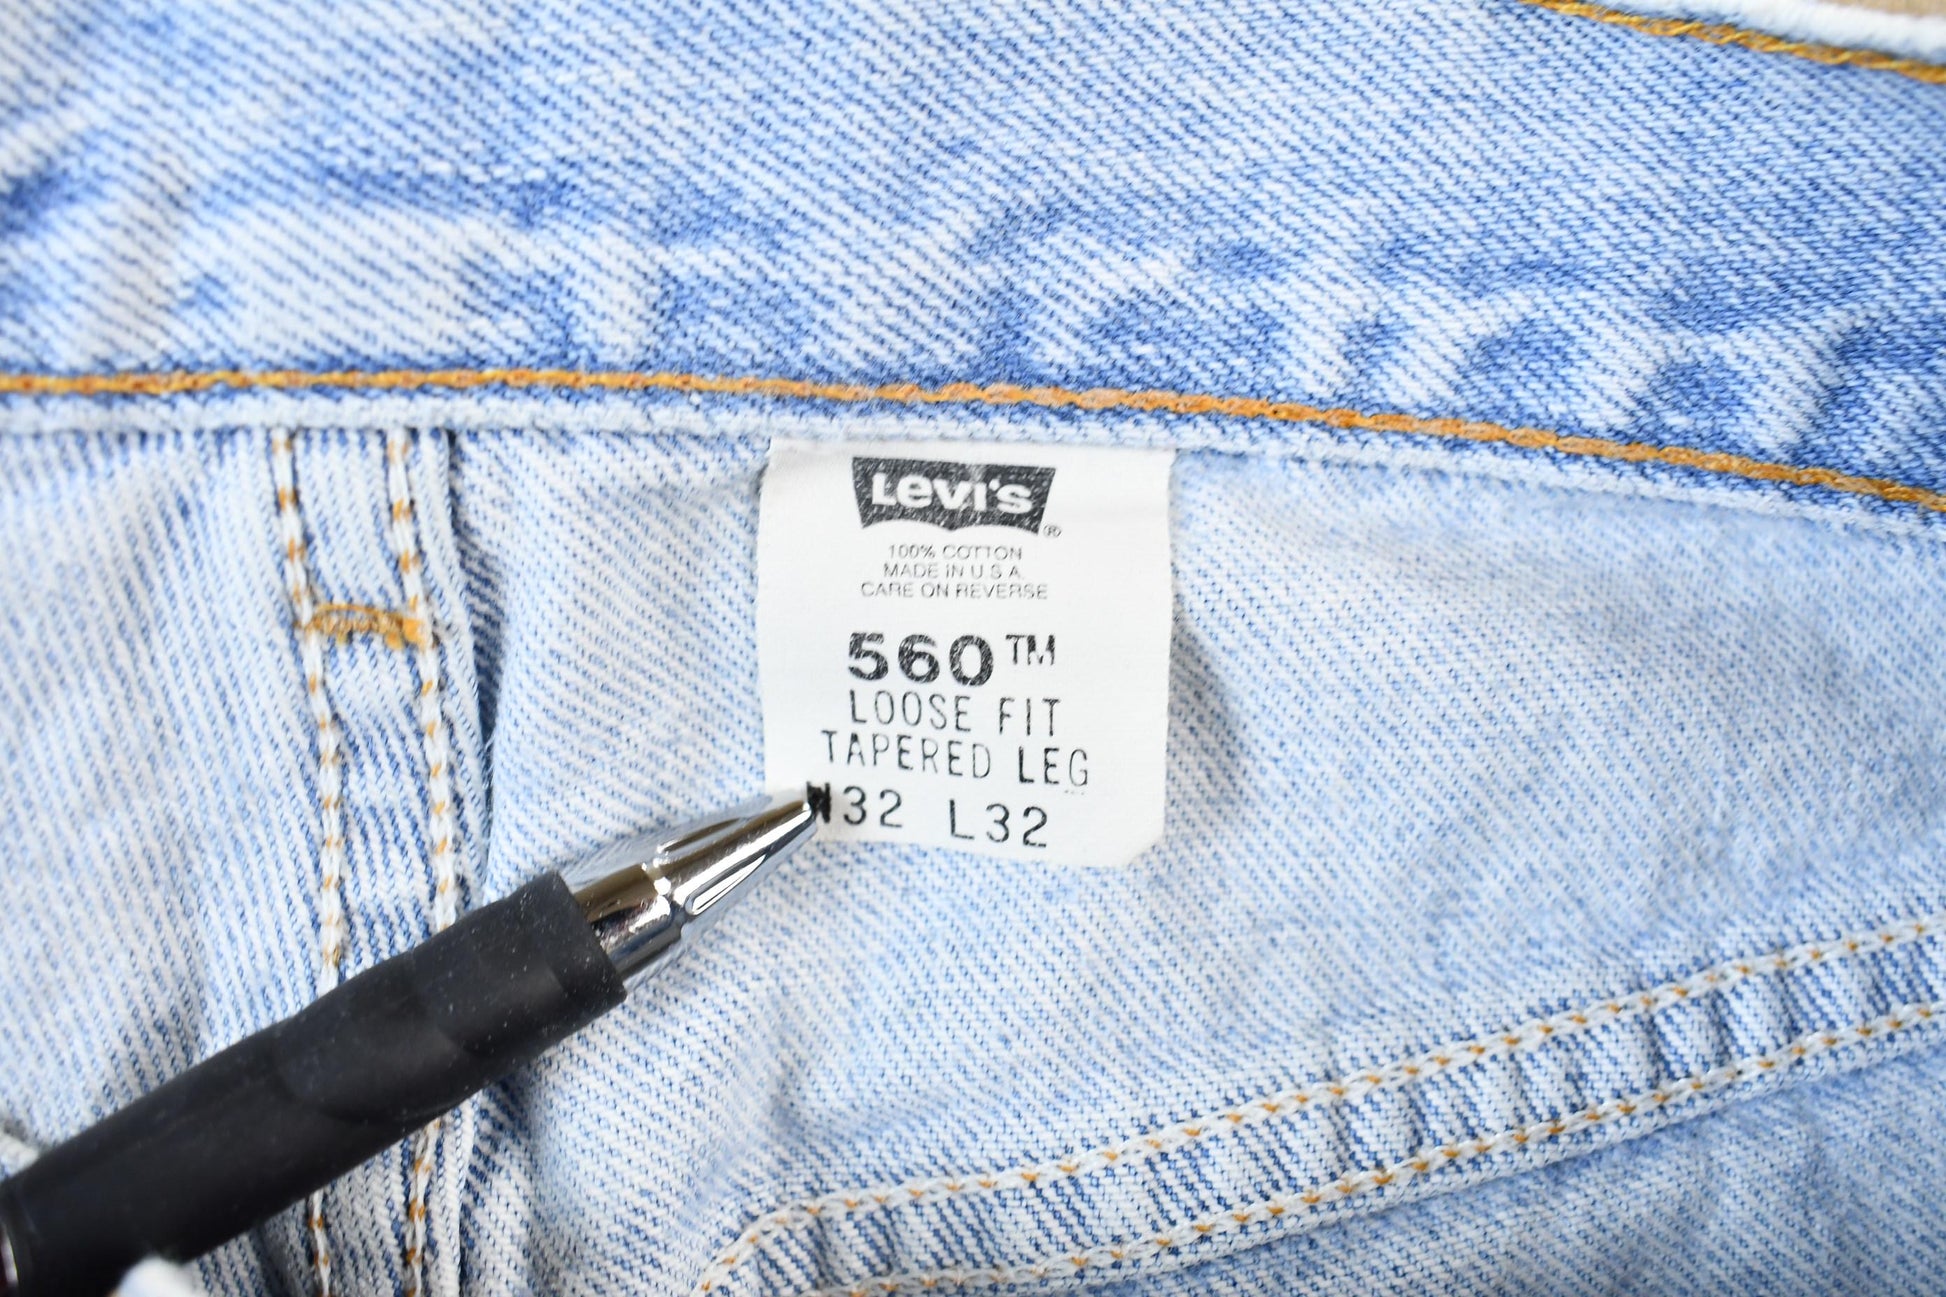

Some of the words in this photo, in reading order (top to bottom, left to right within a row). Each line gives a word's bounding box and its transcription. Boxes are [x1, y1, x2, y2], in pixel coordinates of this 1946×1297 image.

[872, 472, 1033, 515] Levi's
[883, 562, 940, 579] MADE
[946, 563, 964, 577] IN
[888, 544, 936, 559] 100%
[942, 545, 1023, 561] COTTON
[860, 582, 915, 598] CARE
[920, 583, 949, 599] ON
[955, 583, 1049, 600] REVERSE
[849, 689, 972, 733] LOOSE
[999, 697, 1061, 737] FIT
[821, 729, 992, 780] TAPERED
[1018, 745, 1089, 787] LEG
[949, 798, 1049, 849] L32
